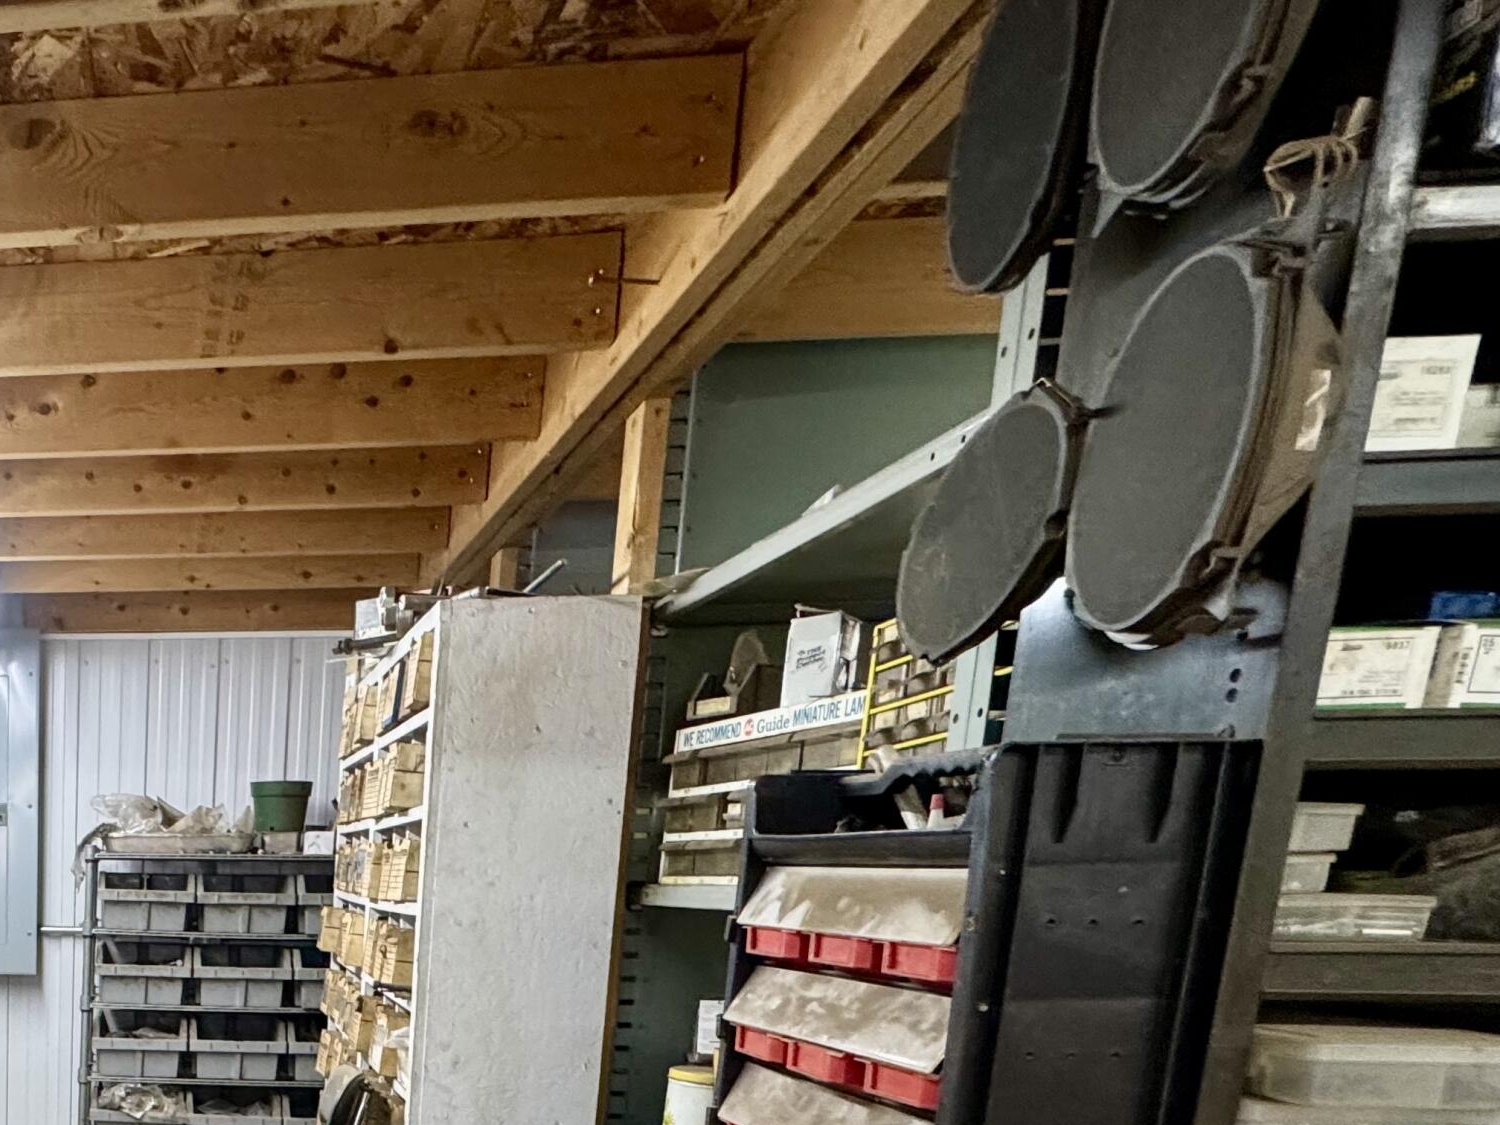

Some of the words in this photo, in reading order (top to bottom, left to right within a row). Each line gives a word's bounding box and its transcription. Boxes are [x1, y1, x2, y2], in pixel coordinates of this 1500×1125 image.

[683, 730, 694, 747] WE
[696, 722, 741, 744] RECOMMEND
[757, 715, 790, 734] Guide
[792, 701, 840, 726] MINIATURE
[844, 695, 866, 717] LAM
